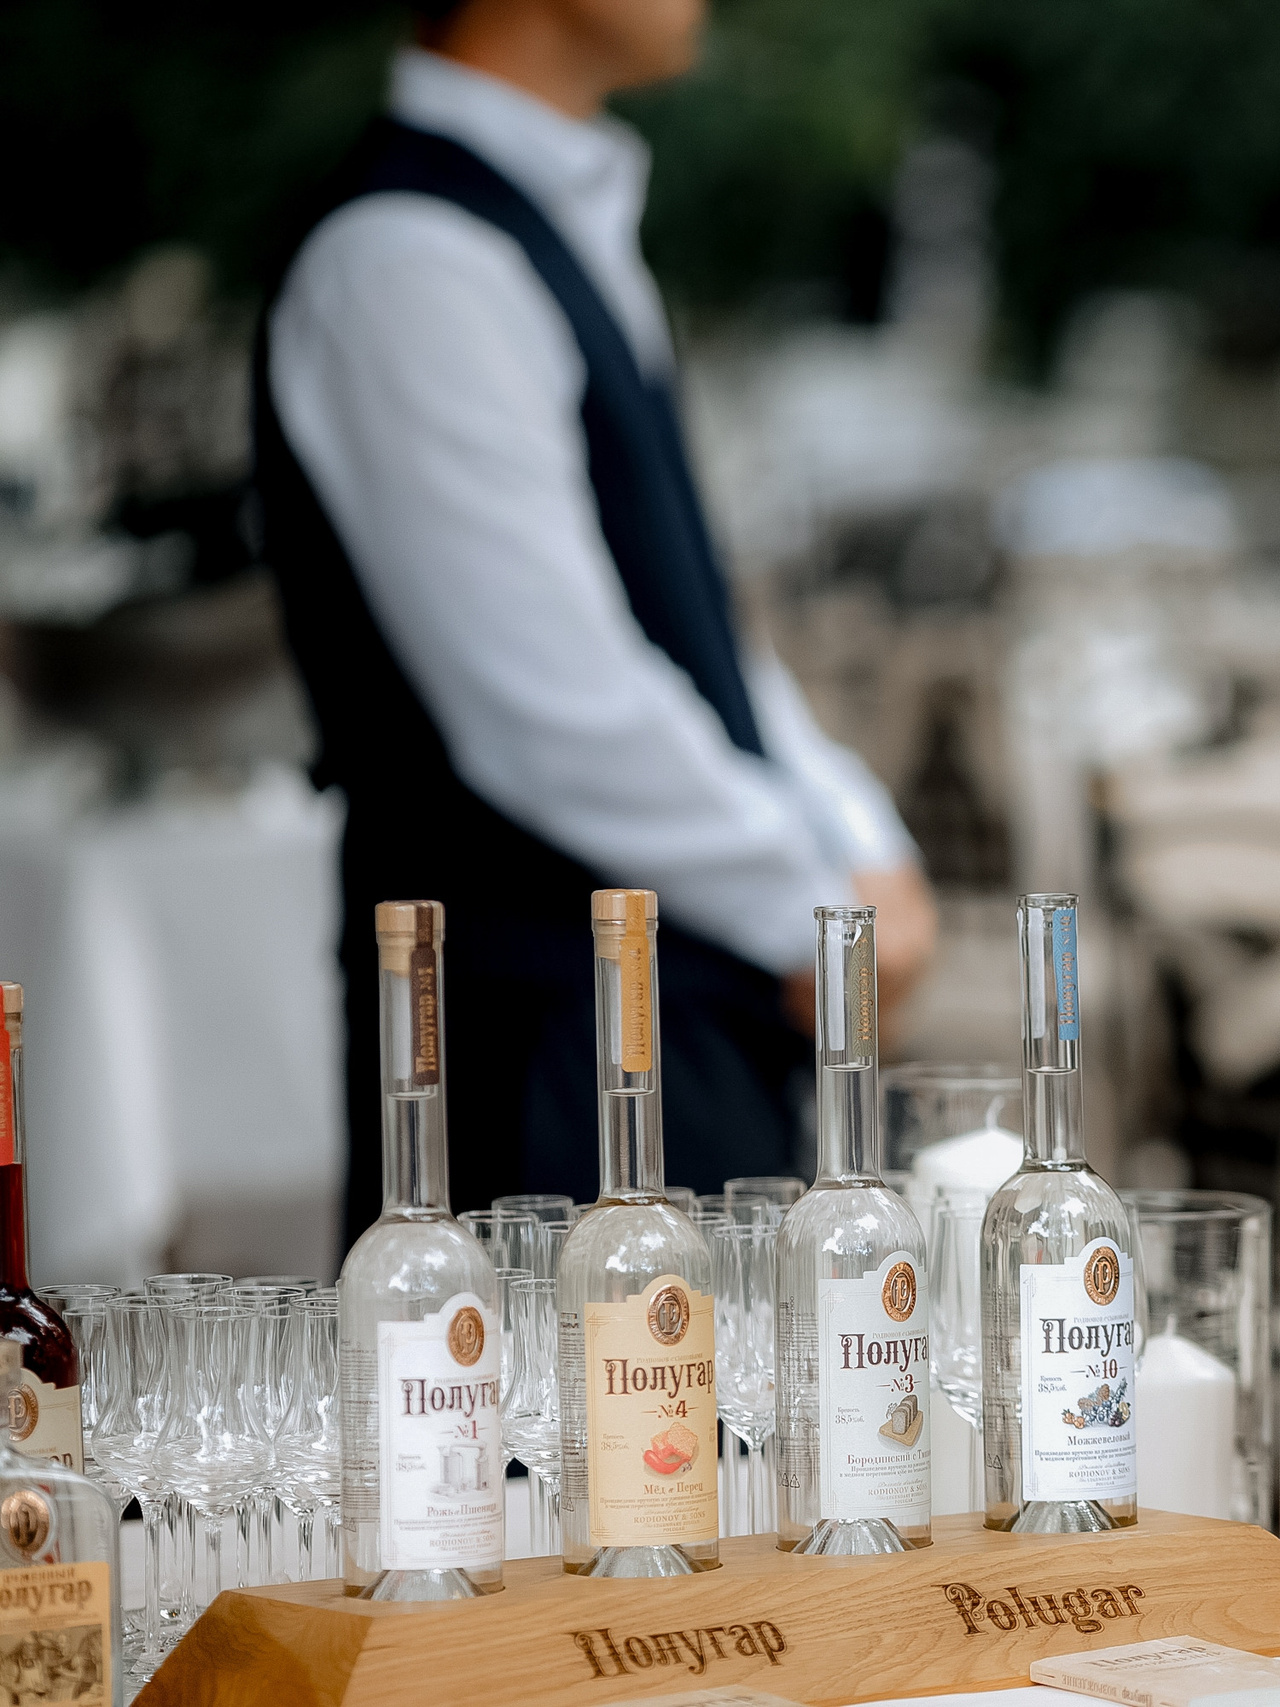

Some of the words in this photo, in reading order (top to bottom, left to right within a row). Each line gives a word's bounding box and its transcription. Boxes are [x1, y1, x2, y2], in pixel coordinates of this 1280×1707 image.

[858, 967, 873, 1041] Полугар
[1059, 952, 1076, 1026] Полугар
[415, 994, 437, 1073] Полугар
[602, 1358, 714, 1399] Полугар
[1067, 1431, 1131, 1446] Можжевеловый
[847, 1451, 911, 1467] Бородинский
[1068, 1469, 1109, 1478] RODIONOV
[643, 1484, 666, 1495] Мёд
[676, 1482, 703, 1495] Перец
[868, 1486, 909, 1496] RODIONOV
[633, 1514, 680, 1524] RODIONOV
[0, 1578, 93, 1613] олугар
[931, 1582, 1146, 1636] Polugar
[569, 1620, 787, 1679] Полугар
